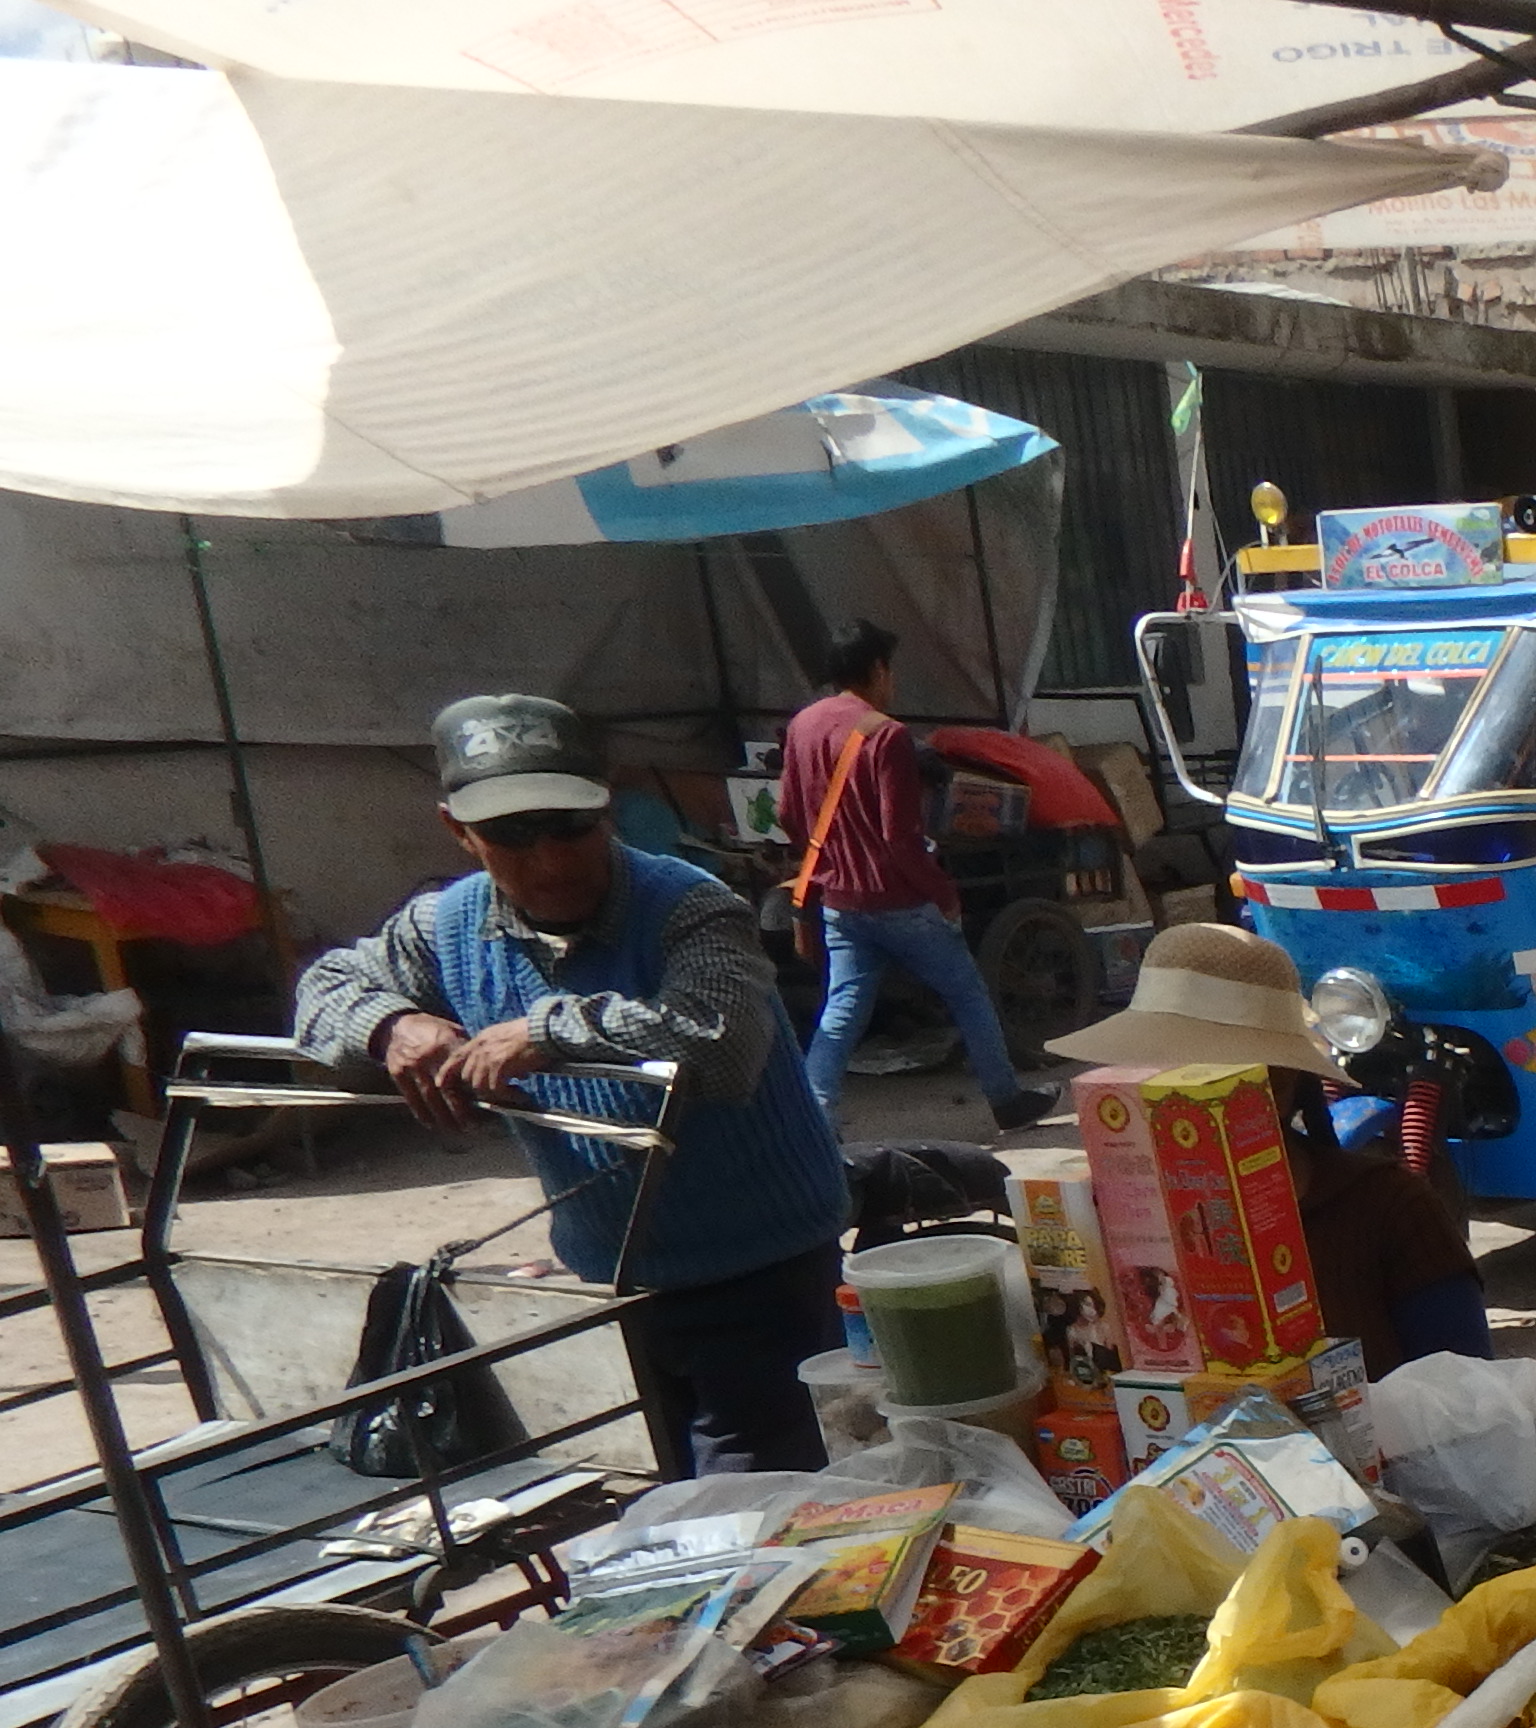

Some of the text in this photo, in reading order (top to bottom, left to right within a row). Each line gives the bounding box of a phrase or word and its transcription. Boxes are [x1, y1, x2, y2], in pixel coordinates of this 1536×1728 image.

[1271, 39, 1411, 63] TRIGO
[1366, 562, 1445, 580] EL COLCA
[1026, 1229, 1082, 1247] PAPA
[839, 1498, 923, 1521] Maca
